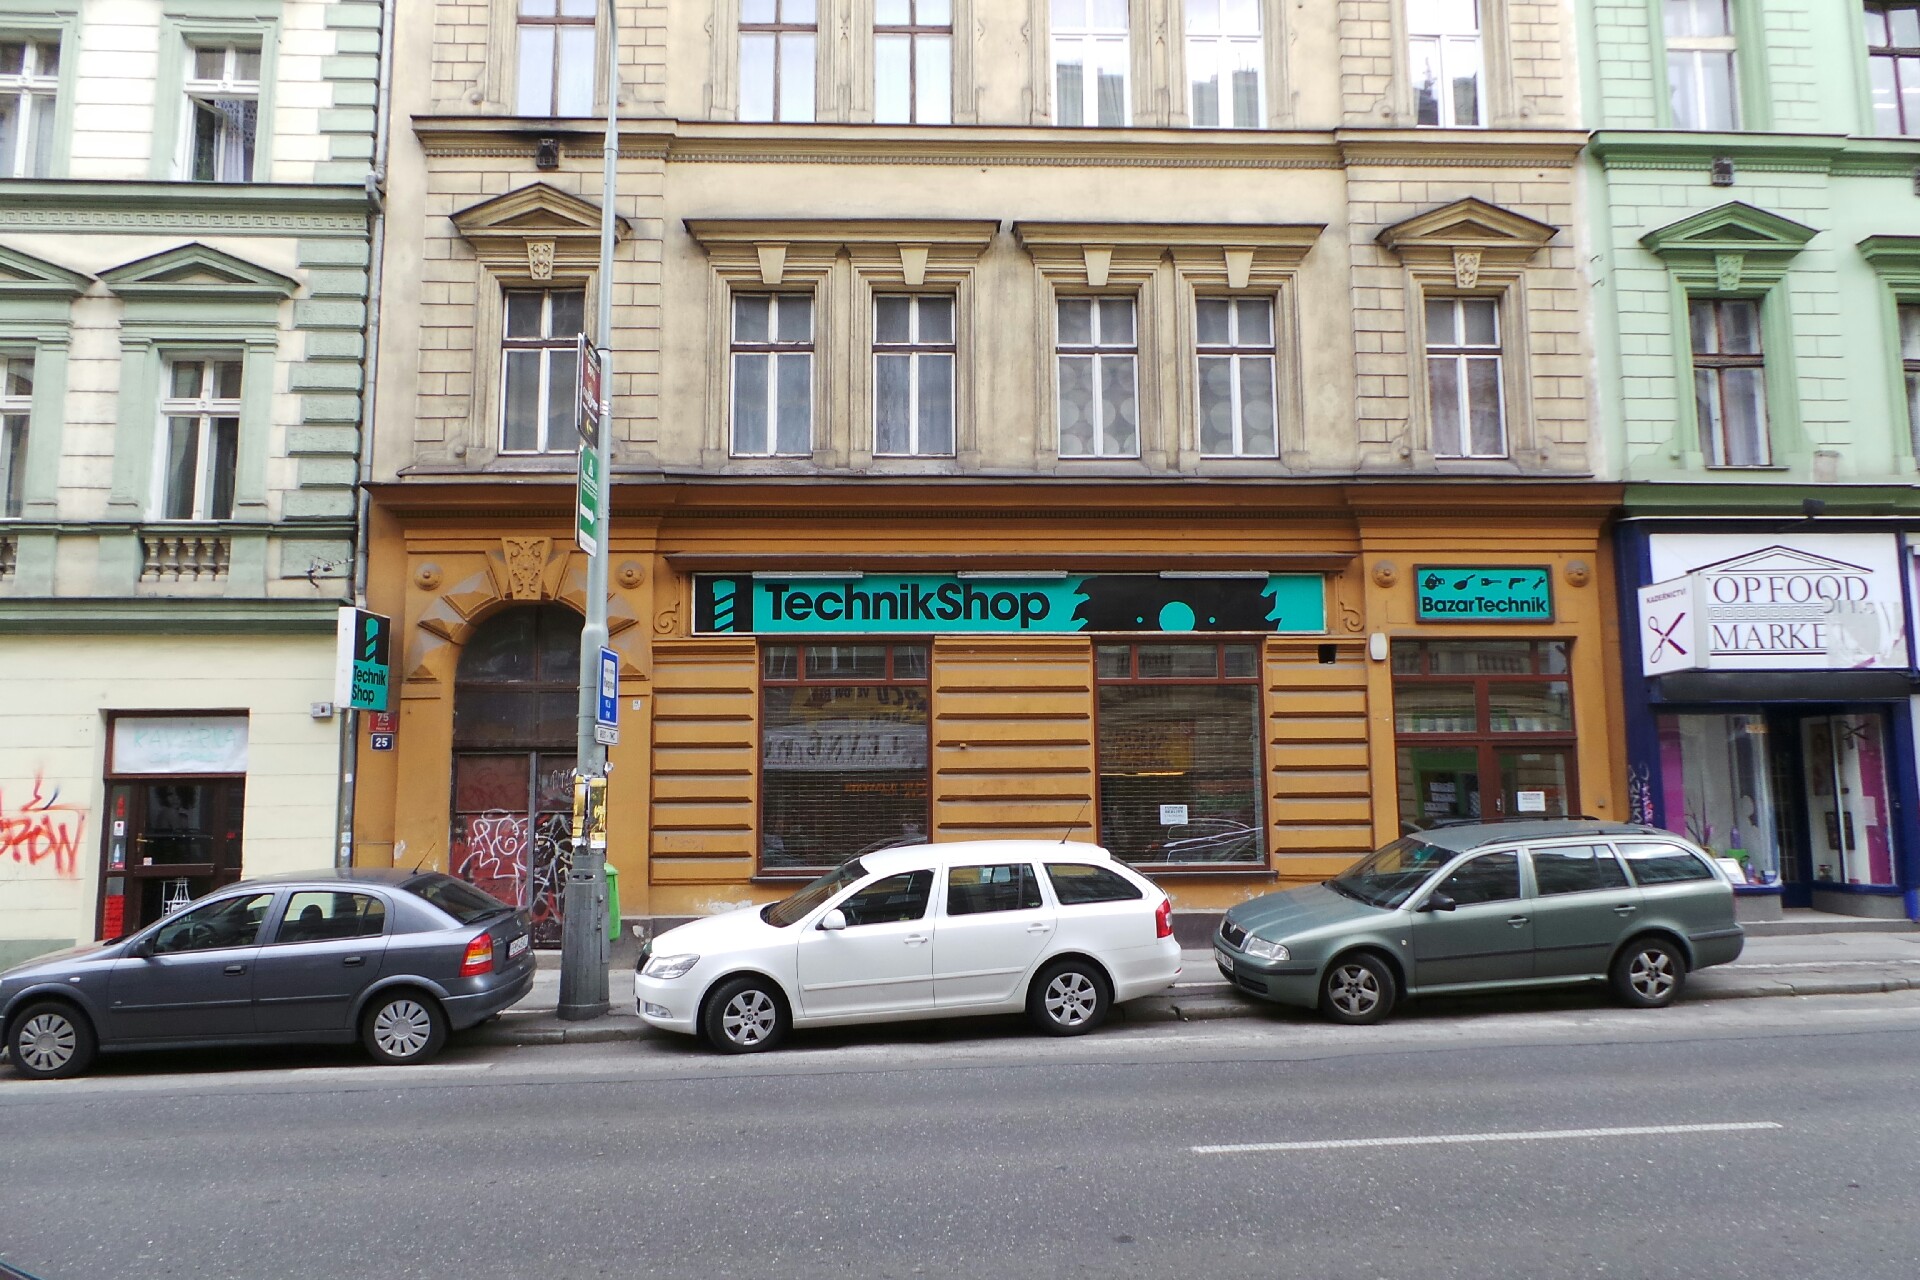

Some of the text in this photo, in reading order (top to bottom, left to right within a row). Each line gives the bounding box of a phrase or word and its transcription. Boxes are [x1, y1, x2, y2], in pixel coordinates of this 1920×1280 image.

[1706, 576, 1761, 603] OP
[765, 583, 1050, 628] TechnikShop
[1422, 597, 1546, 613] BazarTechnik
[353, 665, 386, 686] Technik
[352, 684, 374, 705] Shop
[377, 713, 389, 722] 75
[375, 737, 388, 748] 25
